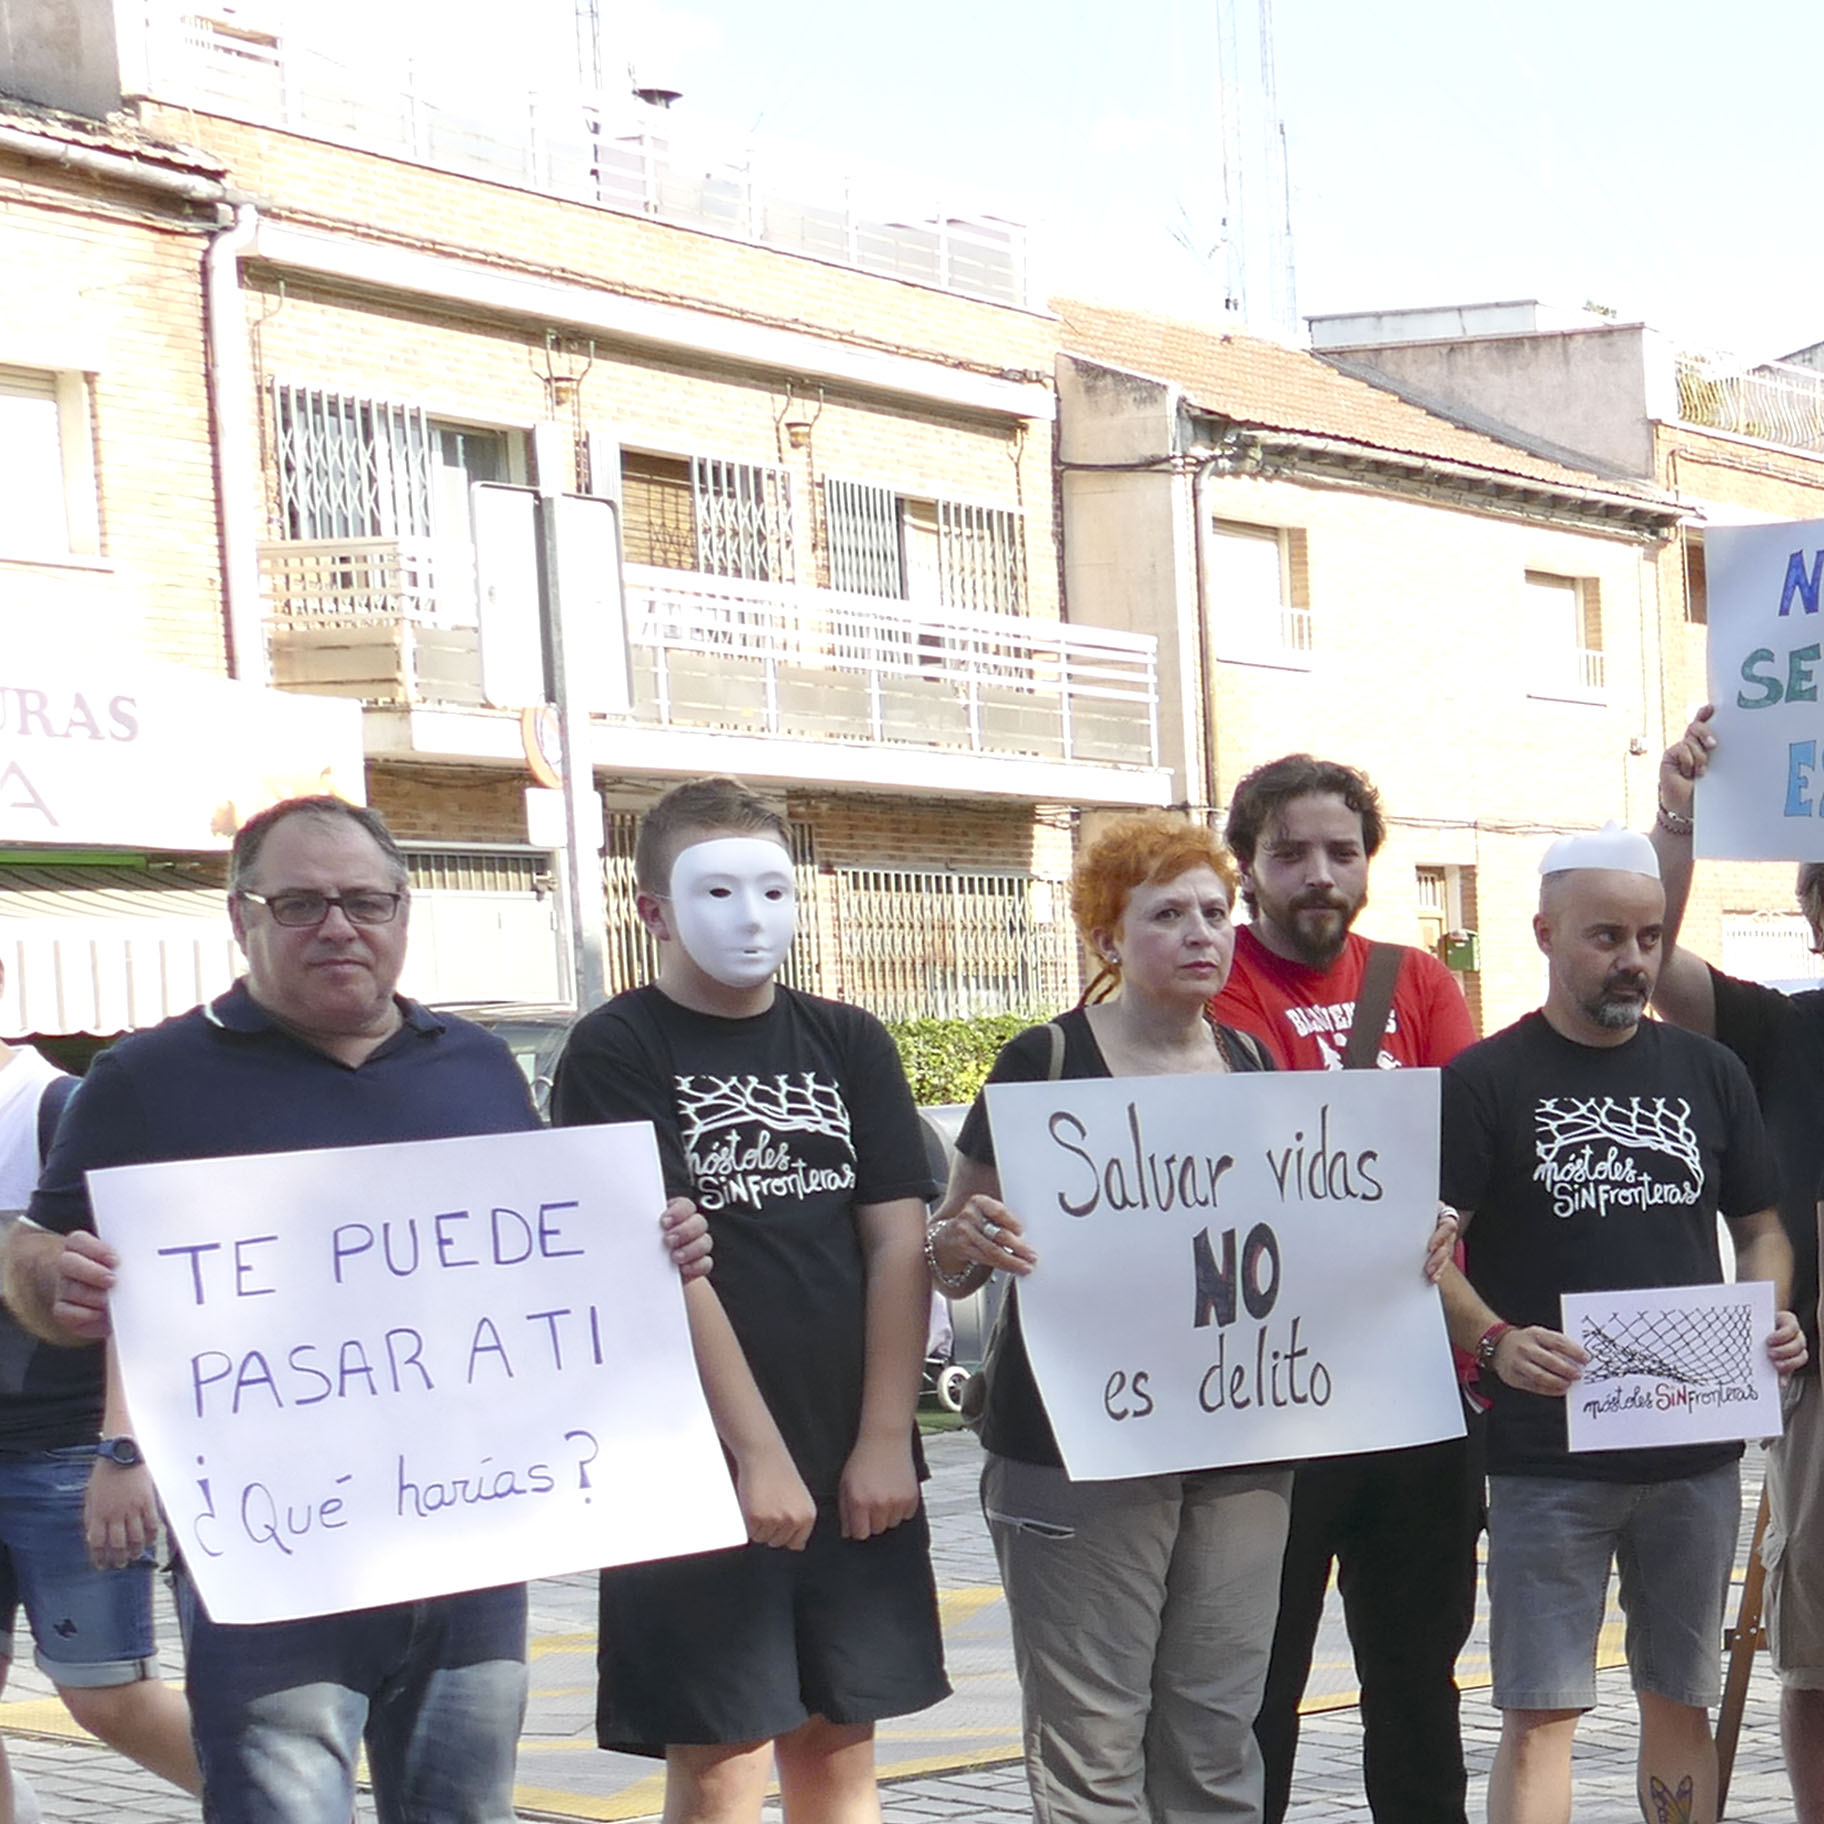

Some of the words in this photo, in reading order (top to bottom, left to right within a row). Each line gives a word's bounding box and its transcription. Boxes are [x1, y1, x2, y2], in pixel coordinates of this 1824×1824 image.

[1048, 1102, 1235, 1217] Salvar
[1265, 1104, 1384, 1203] vidas
[158, 1236, 278, 1305] TE
[333, 1201, 585, 1284] PUEDE
[1192, 1222, 1280, 1329] NO
[190, 1327, 434, 1418] PASAR
[467, 1317, 514, 1383] A
[526, 1305, 603, 1371] TI
[1104, 1368, 1155, 1421] es
[1198, 1317, 1332, 1413] delito
[194, 1455, 356, 1557] ¿Qué
[396, 1430, 600, 1517] harías?
